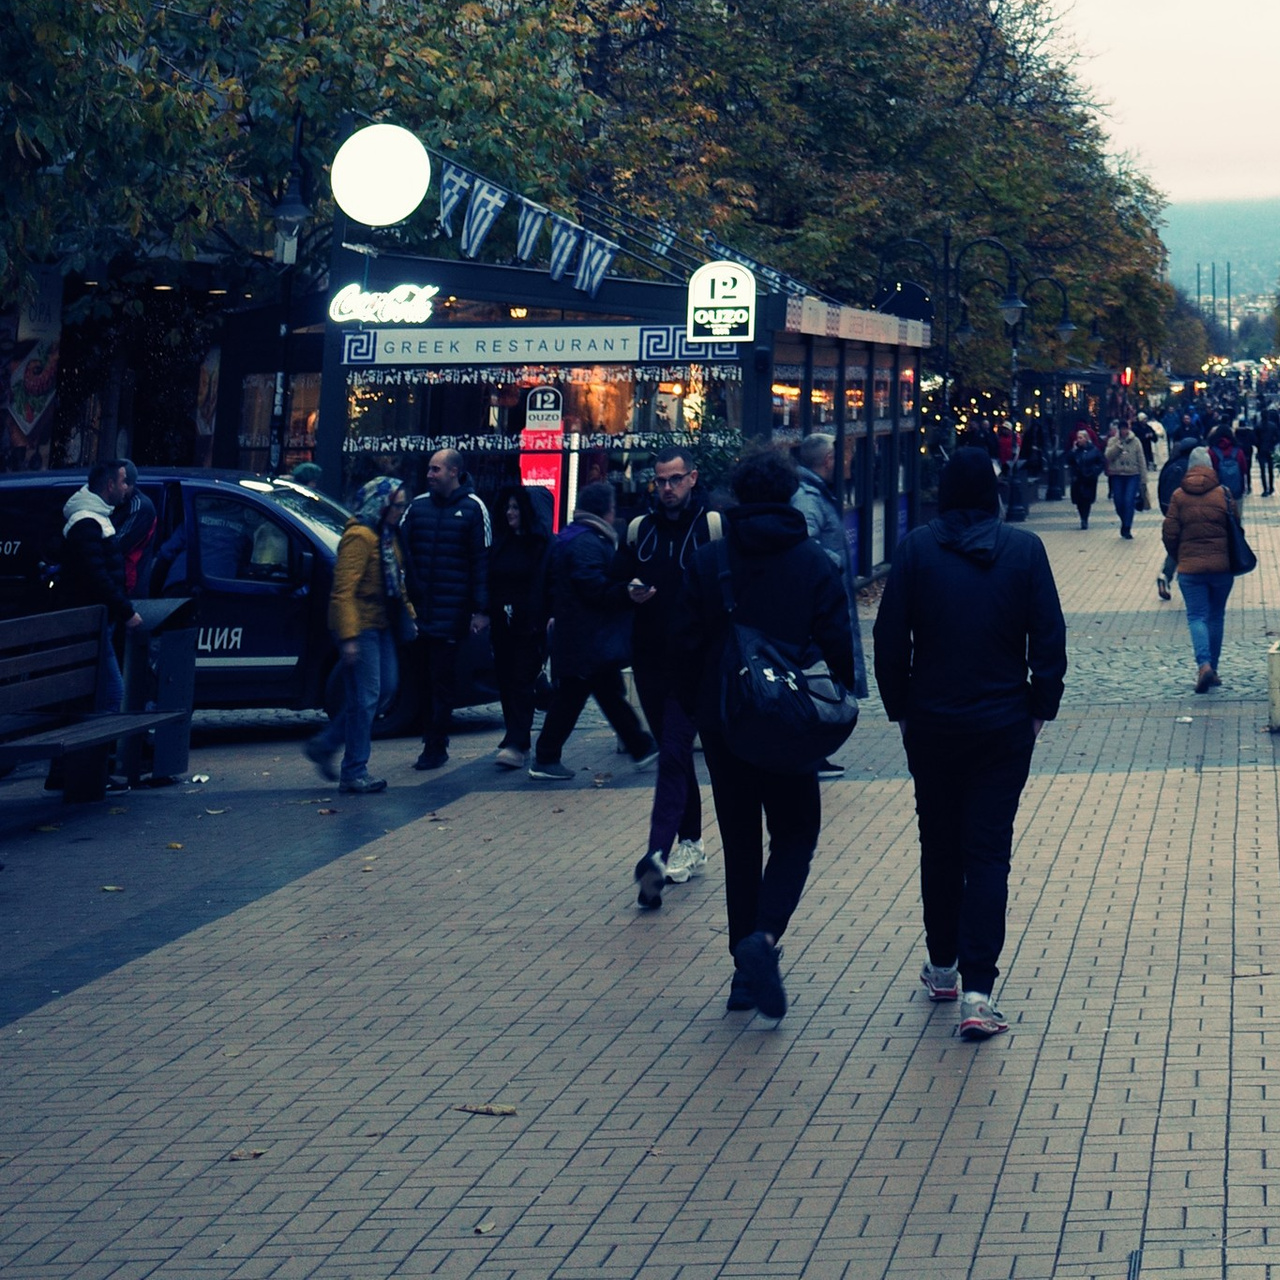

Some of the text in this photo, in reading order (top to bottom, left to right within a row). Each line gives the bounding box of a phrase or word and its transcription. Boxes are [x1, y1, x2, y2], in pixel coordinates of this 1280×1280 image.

[710, 277, 738, 299] 12
[694, 309, 749, 324] OUZO
[384, 338, 630, 354] GREEK RESTAURANT
[535, 392, 555, 409] 12
[528, 413, 560, 421] OUZO
